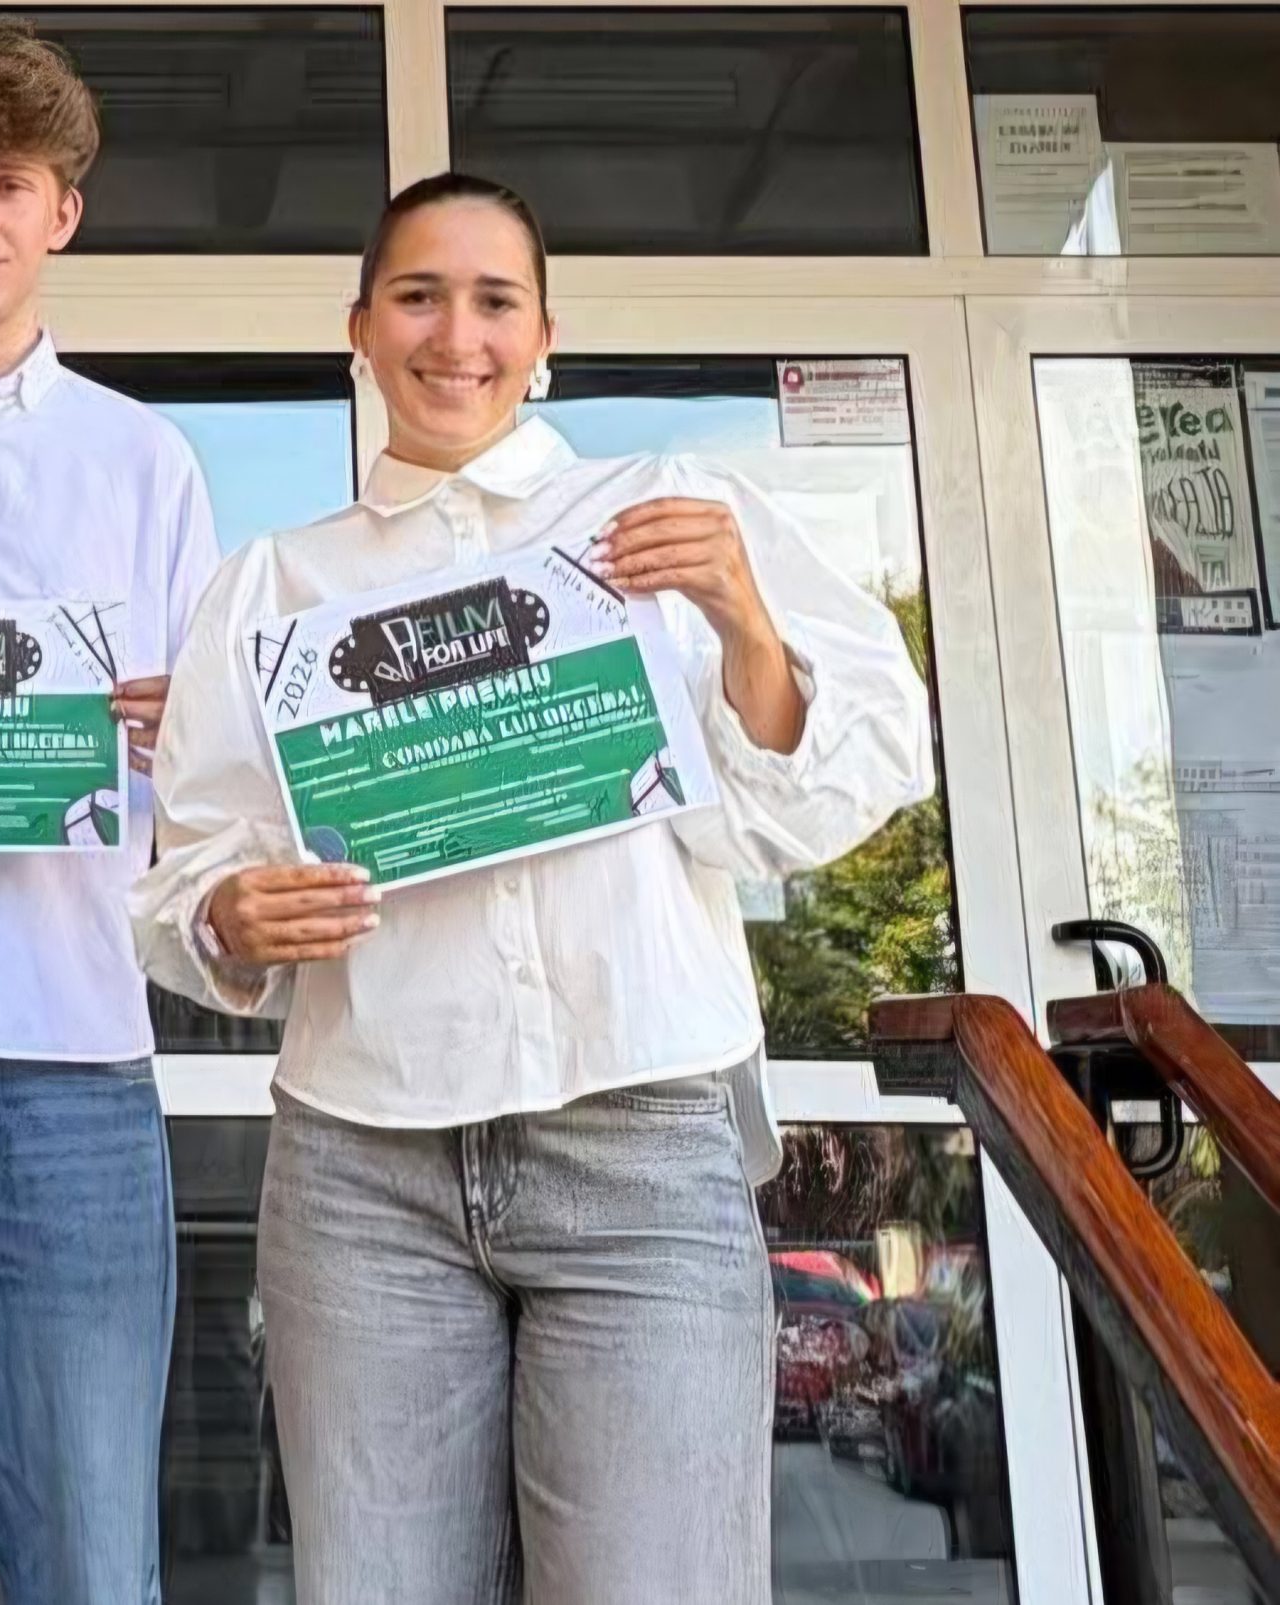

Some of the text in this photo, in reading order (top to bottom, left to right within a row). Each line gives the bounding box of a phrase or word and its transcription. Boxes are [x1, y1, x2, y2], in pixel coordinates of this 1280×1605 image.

[415, 598, 505, 644] FILM
[421, 639, 466, 669] FOR
[277, 648, 318, 719] 2026
[320, 694, 434, 747] MARELE
[439, 664, 552, 714] PREMIU
